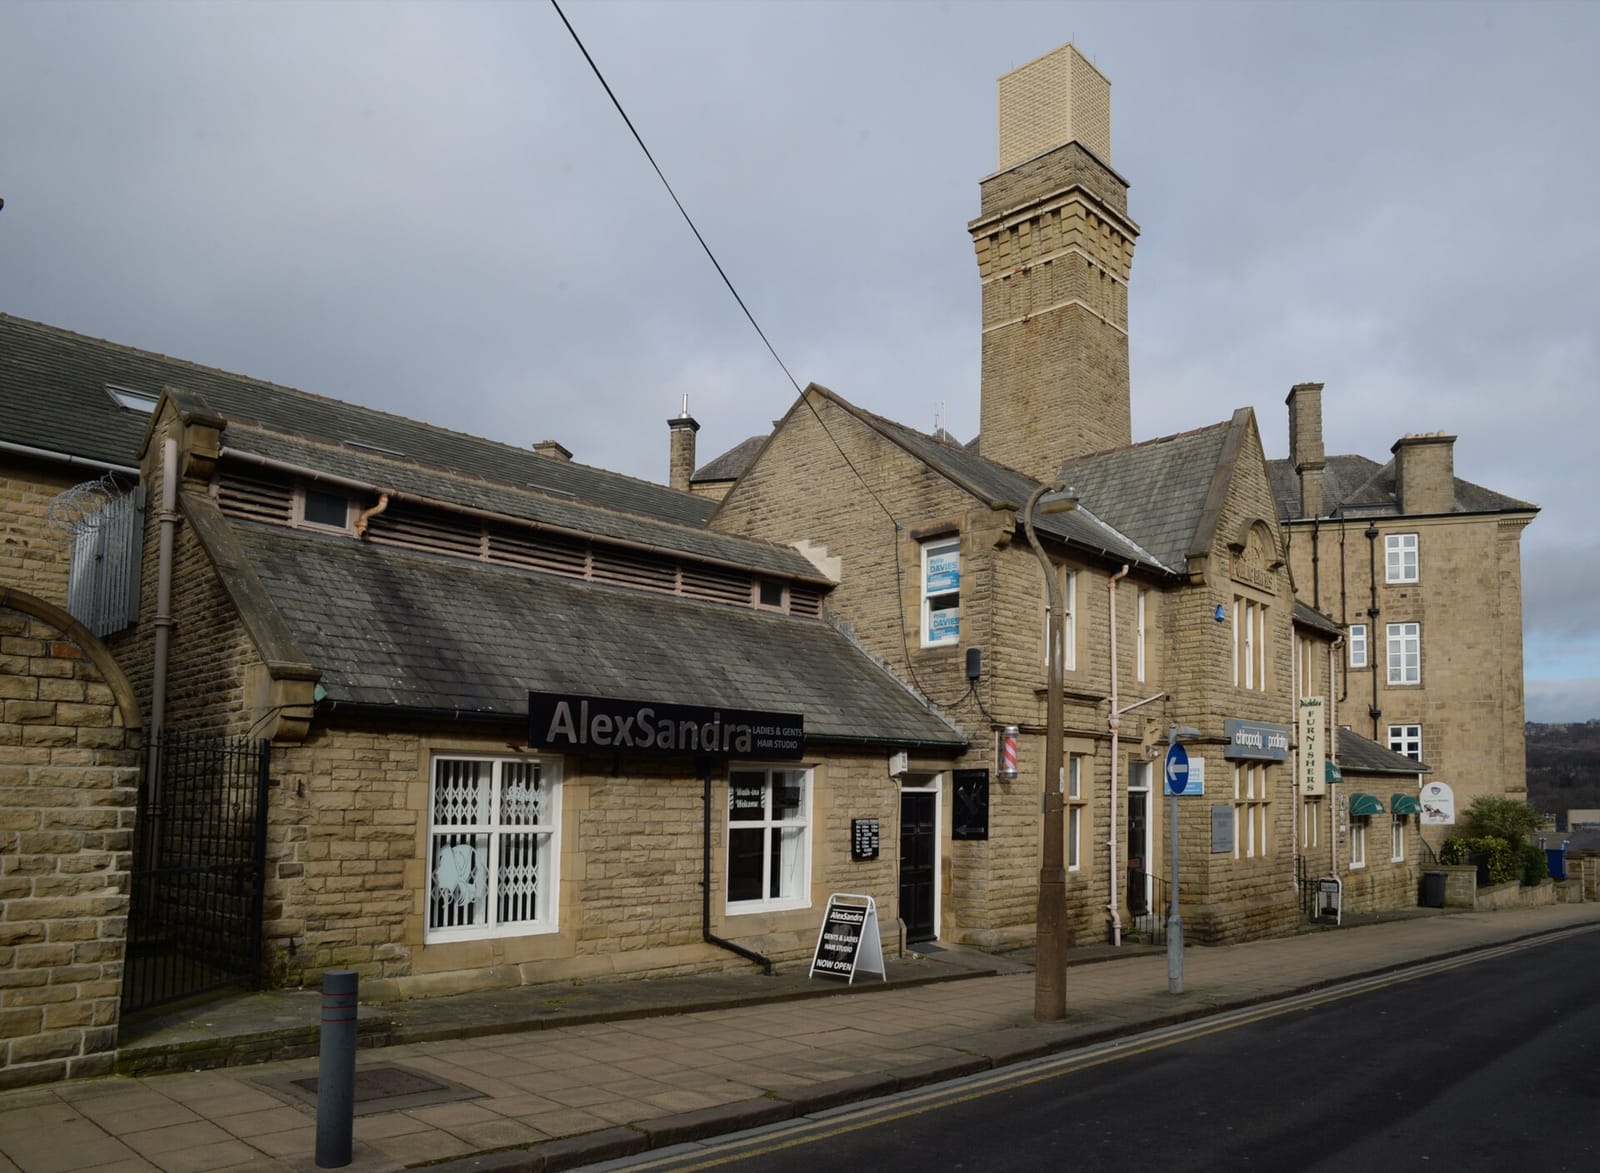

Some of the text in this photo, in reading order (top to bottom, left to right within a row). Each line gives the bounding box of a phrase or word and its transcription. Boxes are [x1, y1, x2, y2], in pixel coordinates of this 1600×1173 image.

[930, 562, 957, 572] DAVIES
[546, 700, 751, 752] AlexSandra
[752, 725, 802, 737] LADIES & GENTS
[757, 739, 798, 749] HAIR STUDIO
[1235, 729, 1262, 749] chiropody
[1306, 710, 1315, 791] FURNISHERS
[830, 911, 863, 921] AlexSandra
[824, 943, 852, 953] HAIR STUDIO
[816, 959, 852, 971] NOW OPEN
